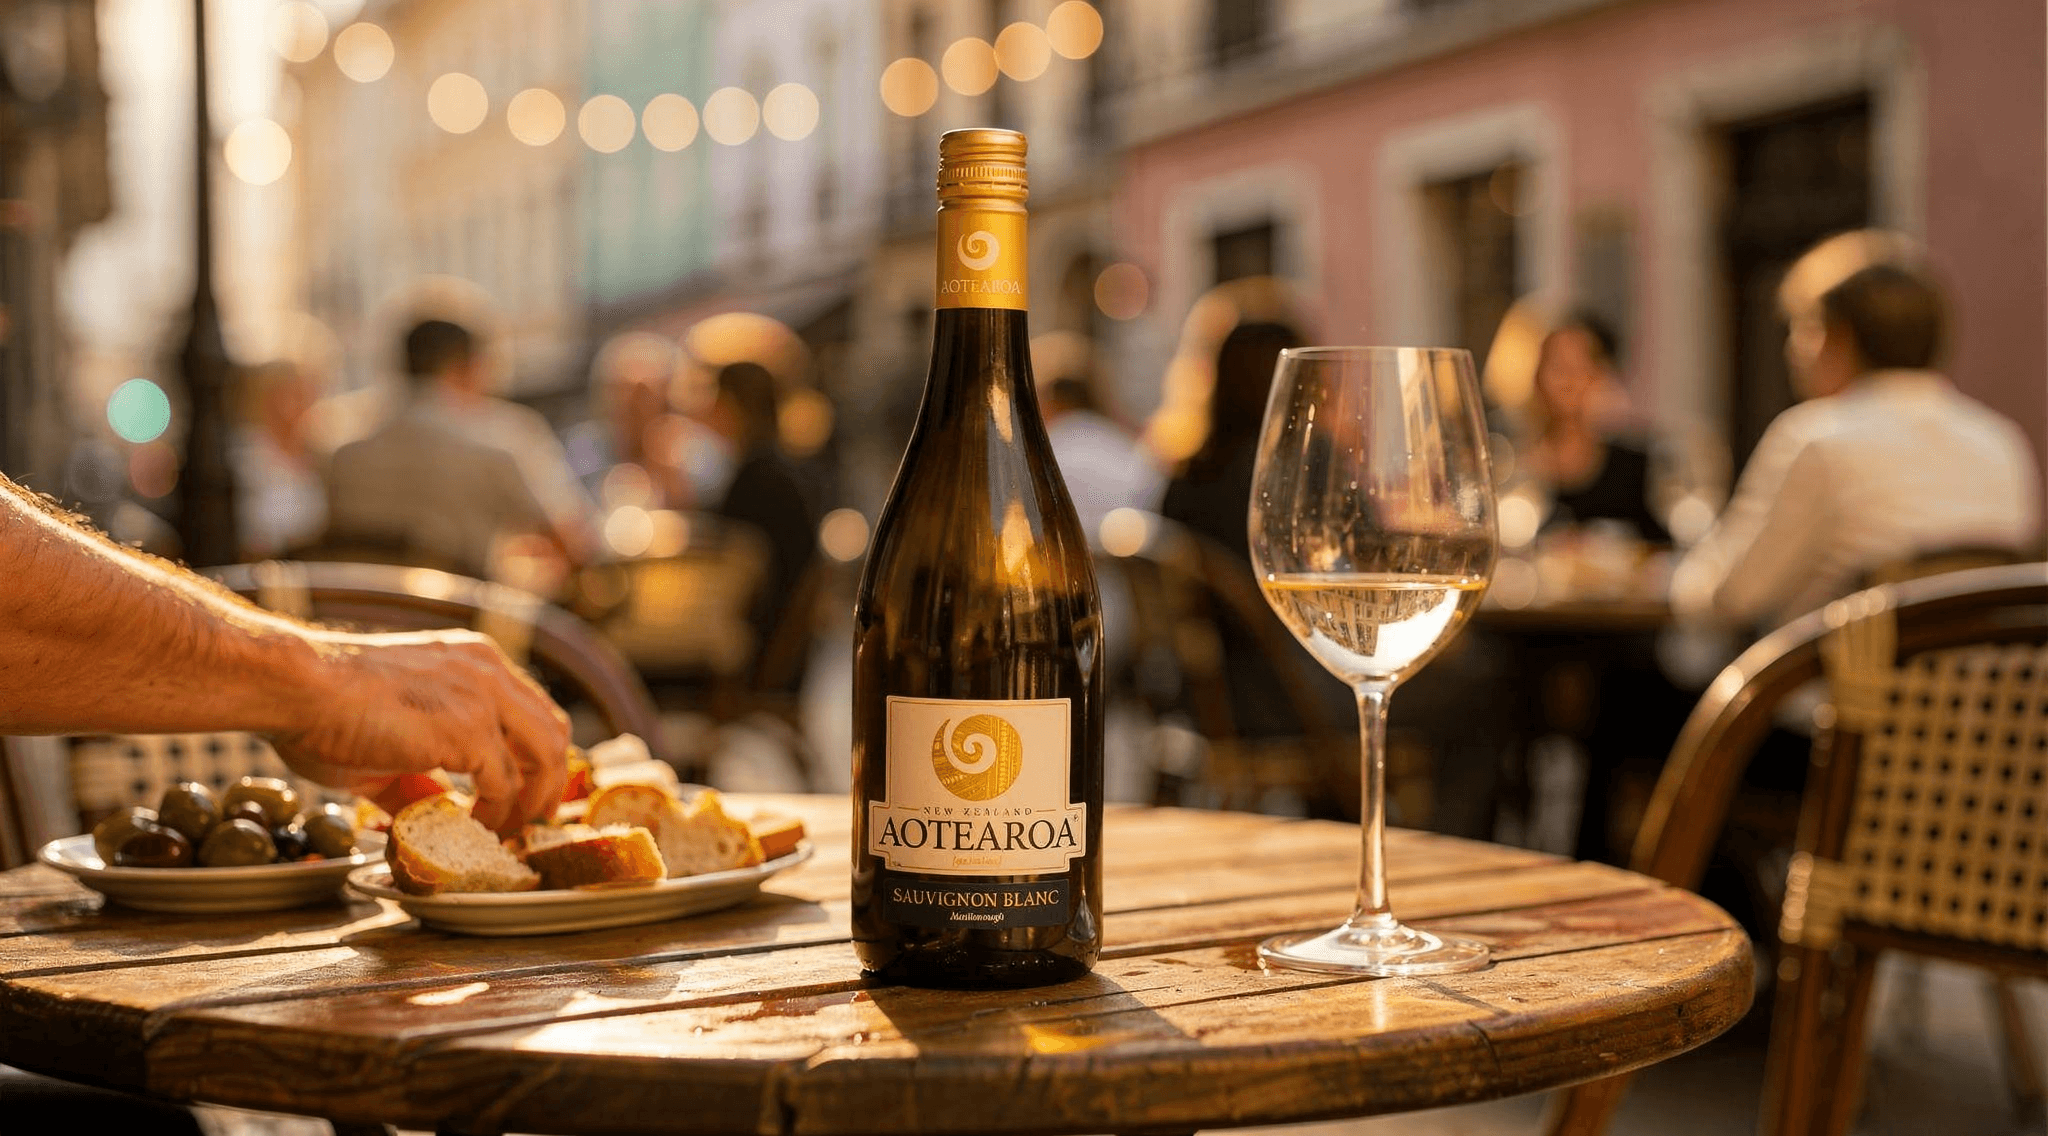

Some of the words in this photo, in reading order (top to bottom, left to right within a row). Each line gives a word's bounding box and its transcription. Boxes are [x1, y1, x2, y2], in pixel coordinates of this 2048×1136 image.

[923, 806, 953, 816] NEW
[963, 807, 1032, 817] ZEALAND
[879, 816, 1077, 850] AOTEAROA
[893, 887, 997, 908] SAUVIGNON
[1003, 889, 1060, 907] BLANC
